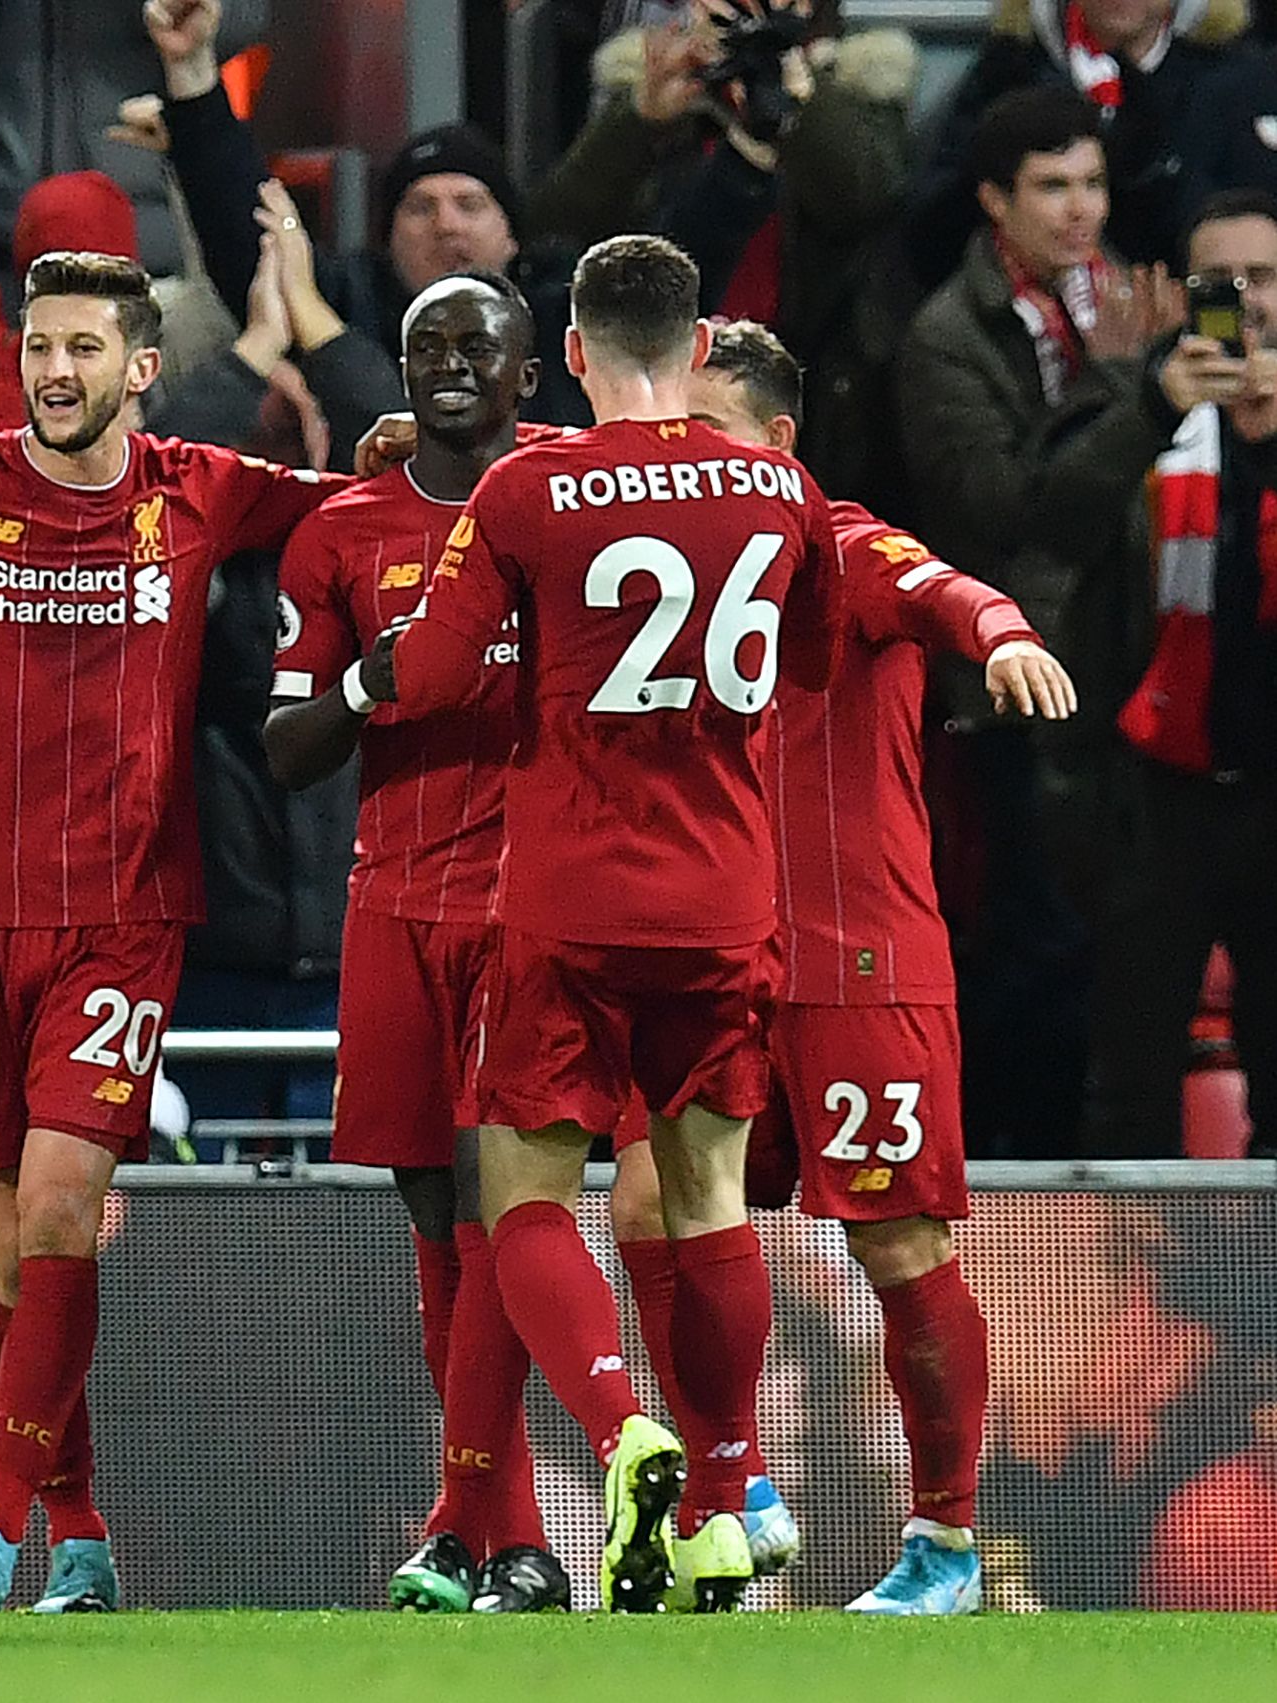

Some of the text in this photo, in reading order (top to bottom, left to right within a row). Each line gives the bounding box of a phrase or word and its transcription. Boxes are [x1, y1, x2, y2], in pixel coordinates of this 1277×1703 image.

[548, 458, 805, 512] ROBERTSON
[584, 532, 785, 714] 26
[69, 987, 163, 1076] 20
[820, 1081, 924, 1163] 23
